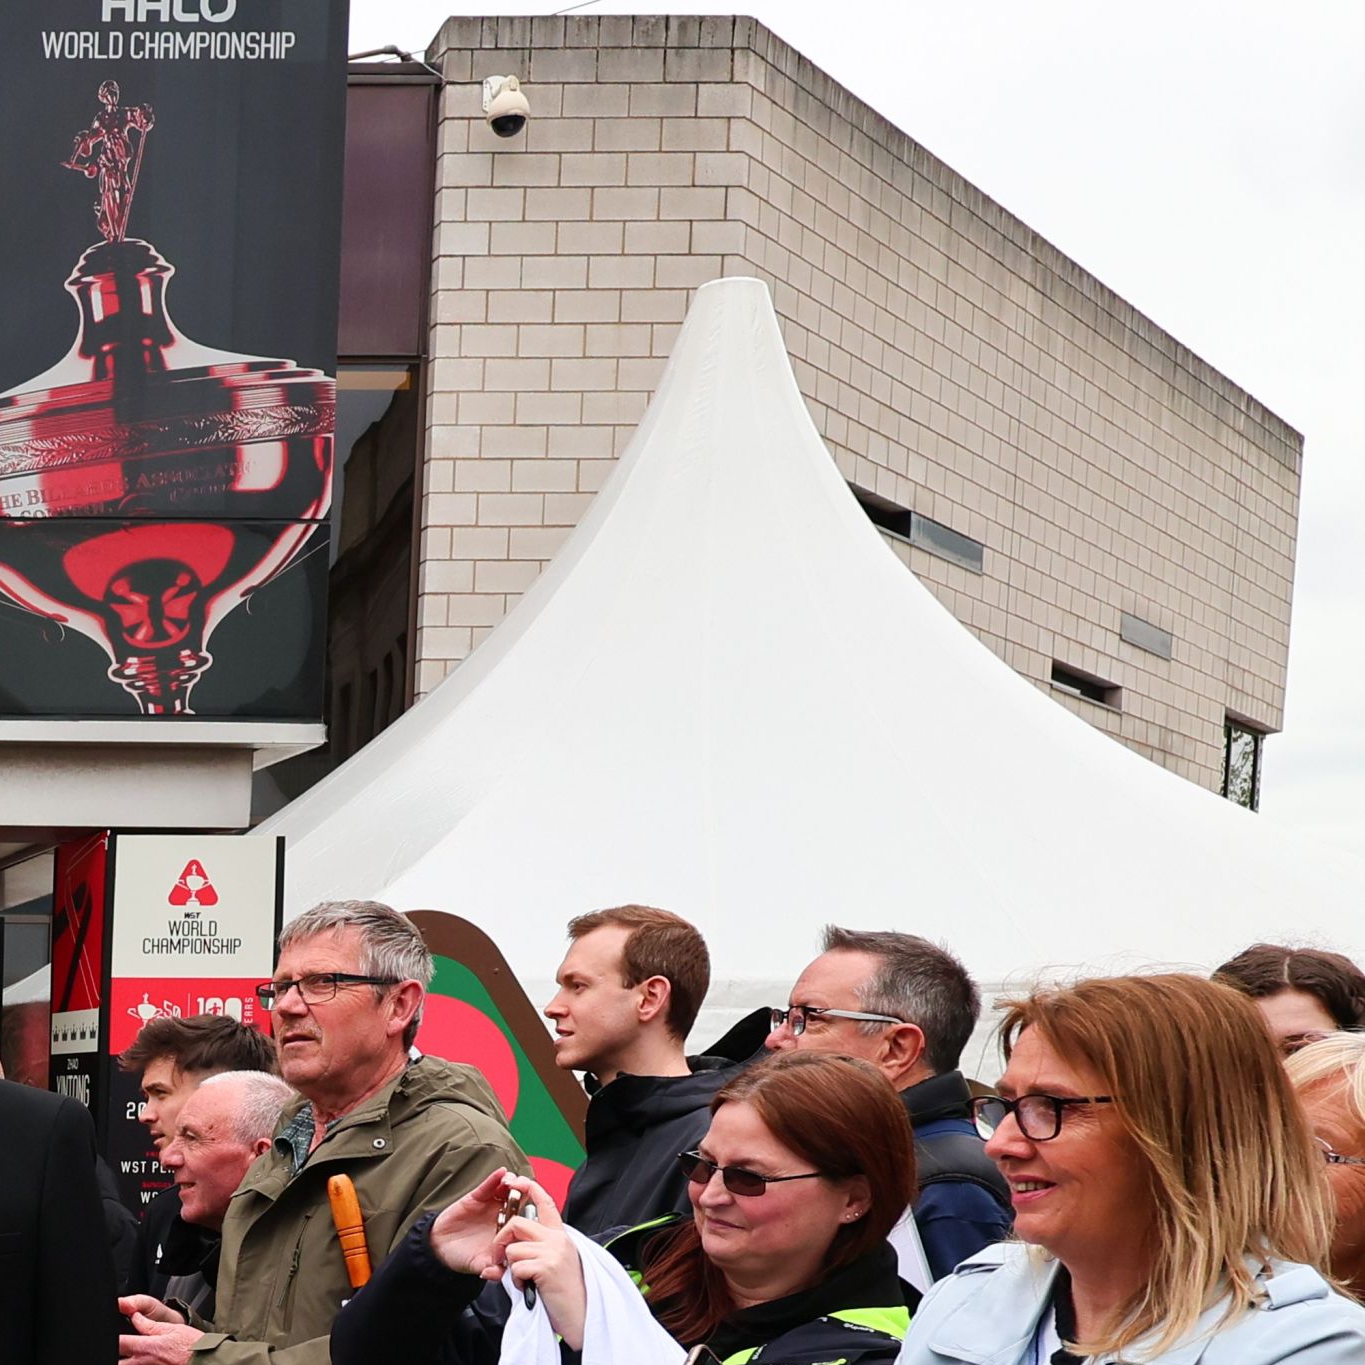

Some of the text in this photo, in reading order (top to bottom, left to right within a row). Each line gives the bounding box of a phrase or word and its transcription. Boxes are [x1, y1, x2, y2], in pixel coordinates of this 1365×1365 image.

[41, 31, 295, 59] WORLD CHAMPIONSHIP
[168, 920, 217, 936] WORLD
[142, 938, 242, 954] CHAMPIONSHIP
[243, 997, 254, 1024] EARS
[121, 1161, 147, 1174] WST
